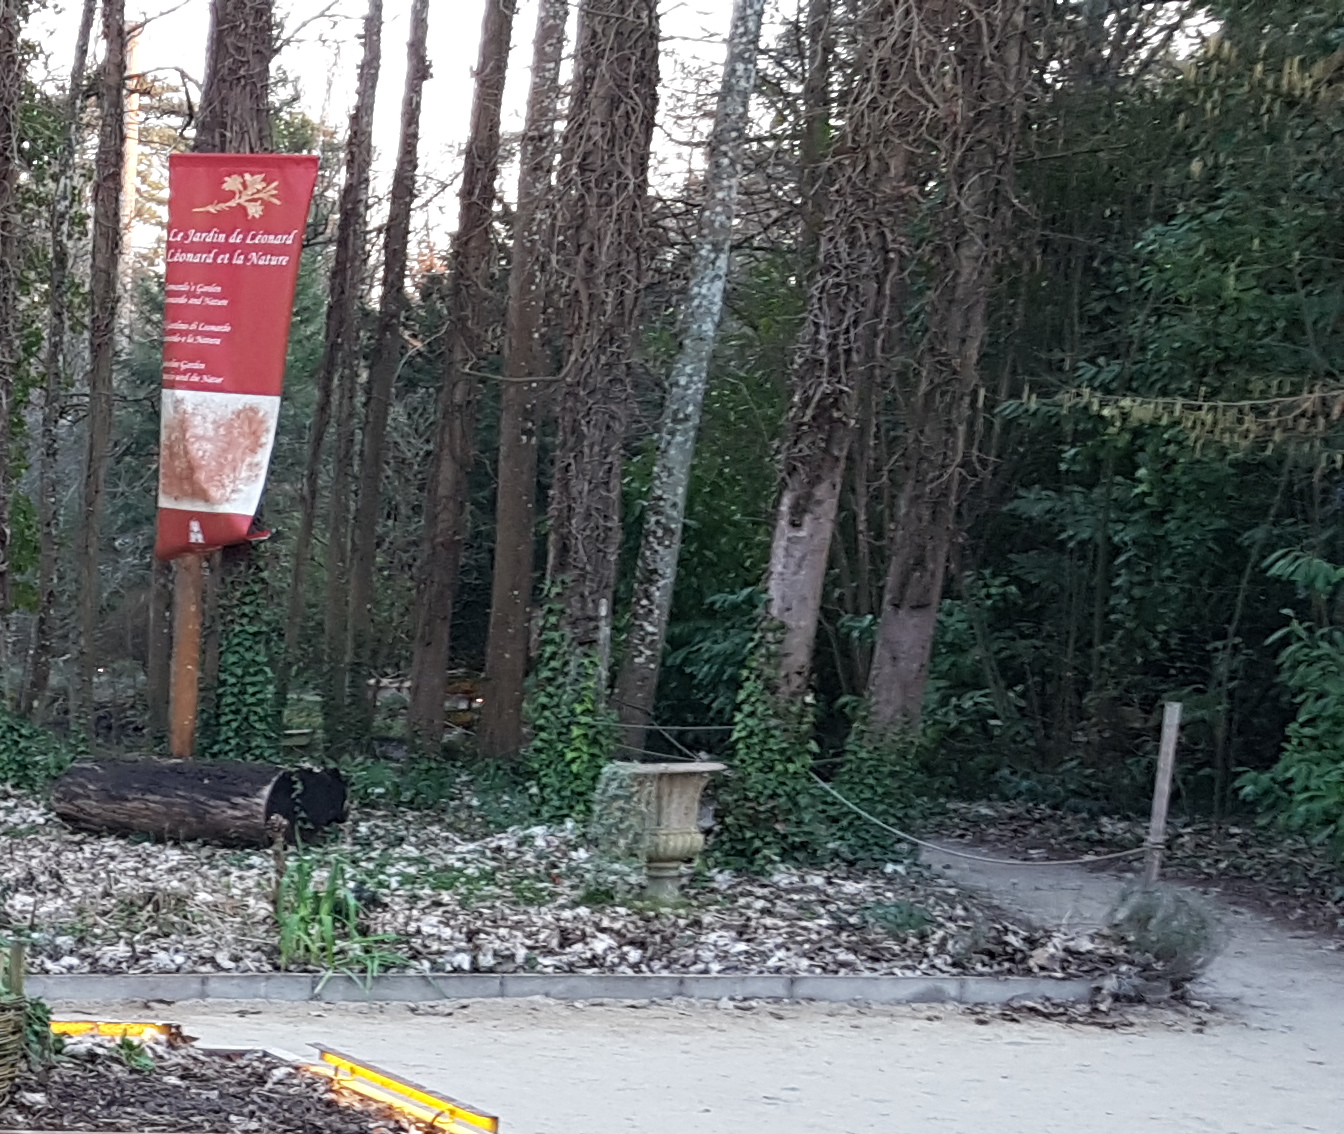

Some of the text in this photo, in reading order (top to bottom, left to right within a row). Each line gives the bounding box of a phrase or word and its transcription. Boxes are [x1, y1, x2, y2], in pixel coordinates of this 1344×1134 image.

[169, 228, 298, 245] Le Jardin de Léonard
[166, 248, 290, 266] Léonard et la Nature
